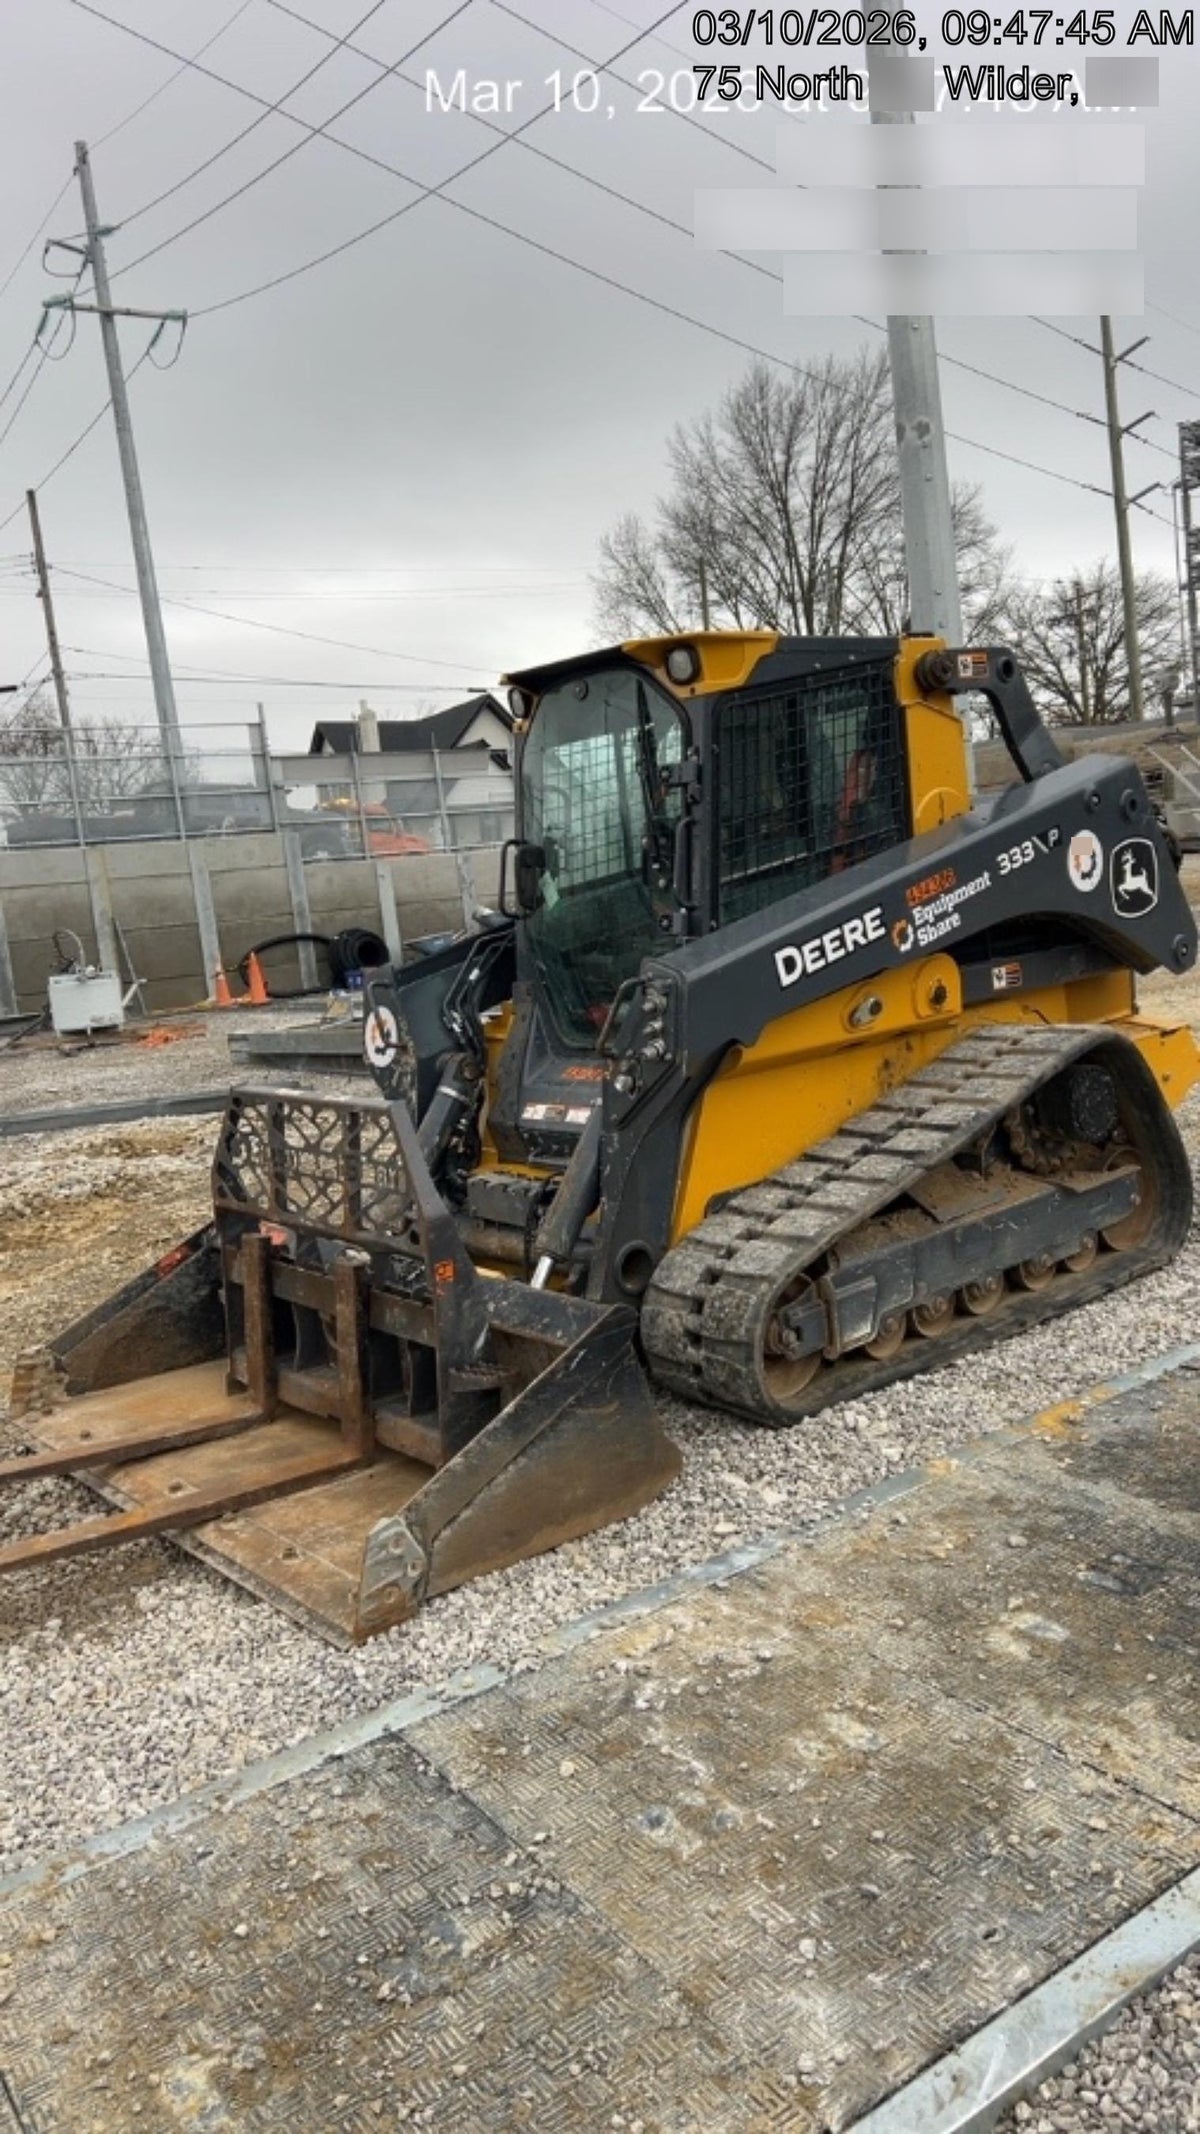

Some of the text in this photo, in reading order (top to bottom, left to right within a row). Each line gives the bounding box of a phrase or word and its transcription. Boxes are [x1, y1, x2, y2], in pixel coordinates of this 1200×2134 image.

[912, 871, 992, 926] Equipment
[775, 907, 886, 987] DEERE
[916, 911, 962, 948] Share
